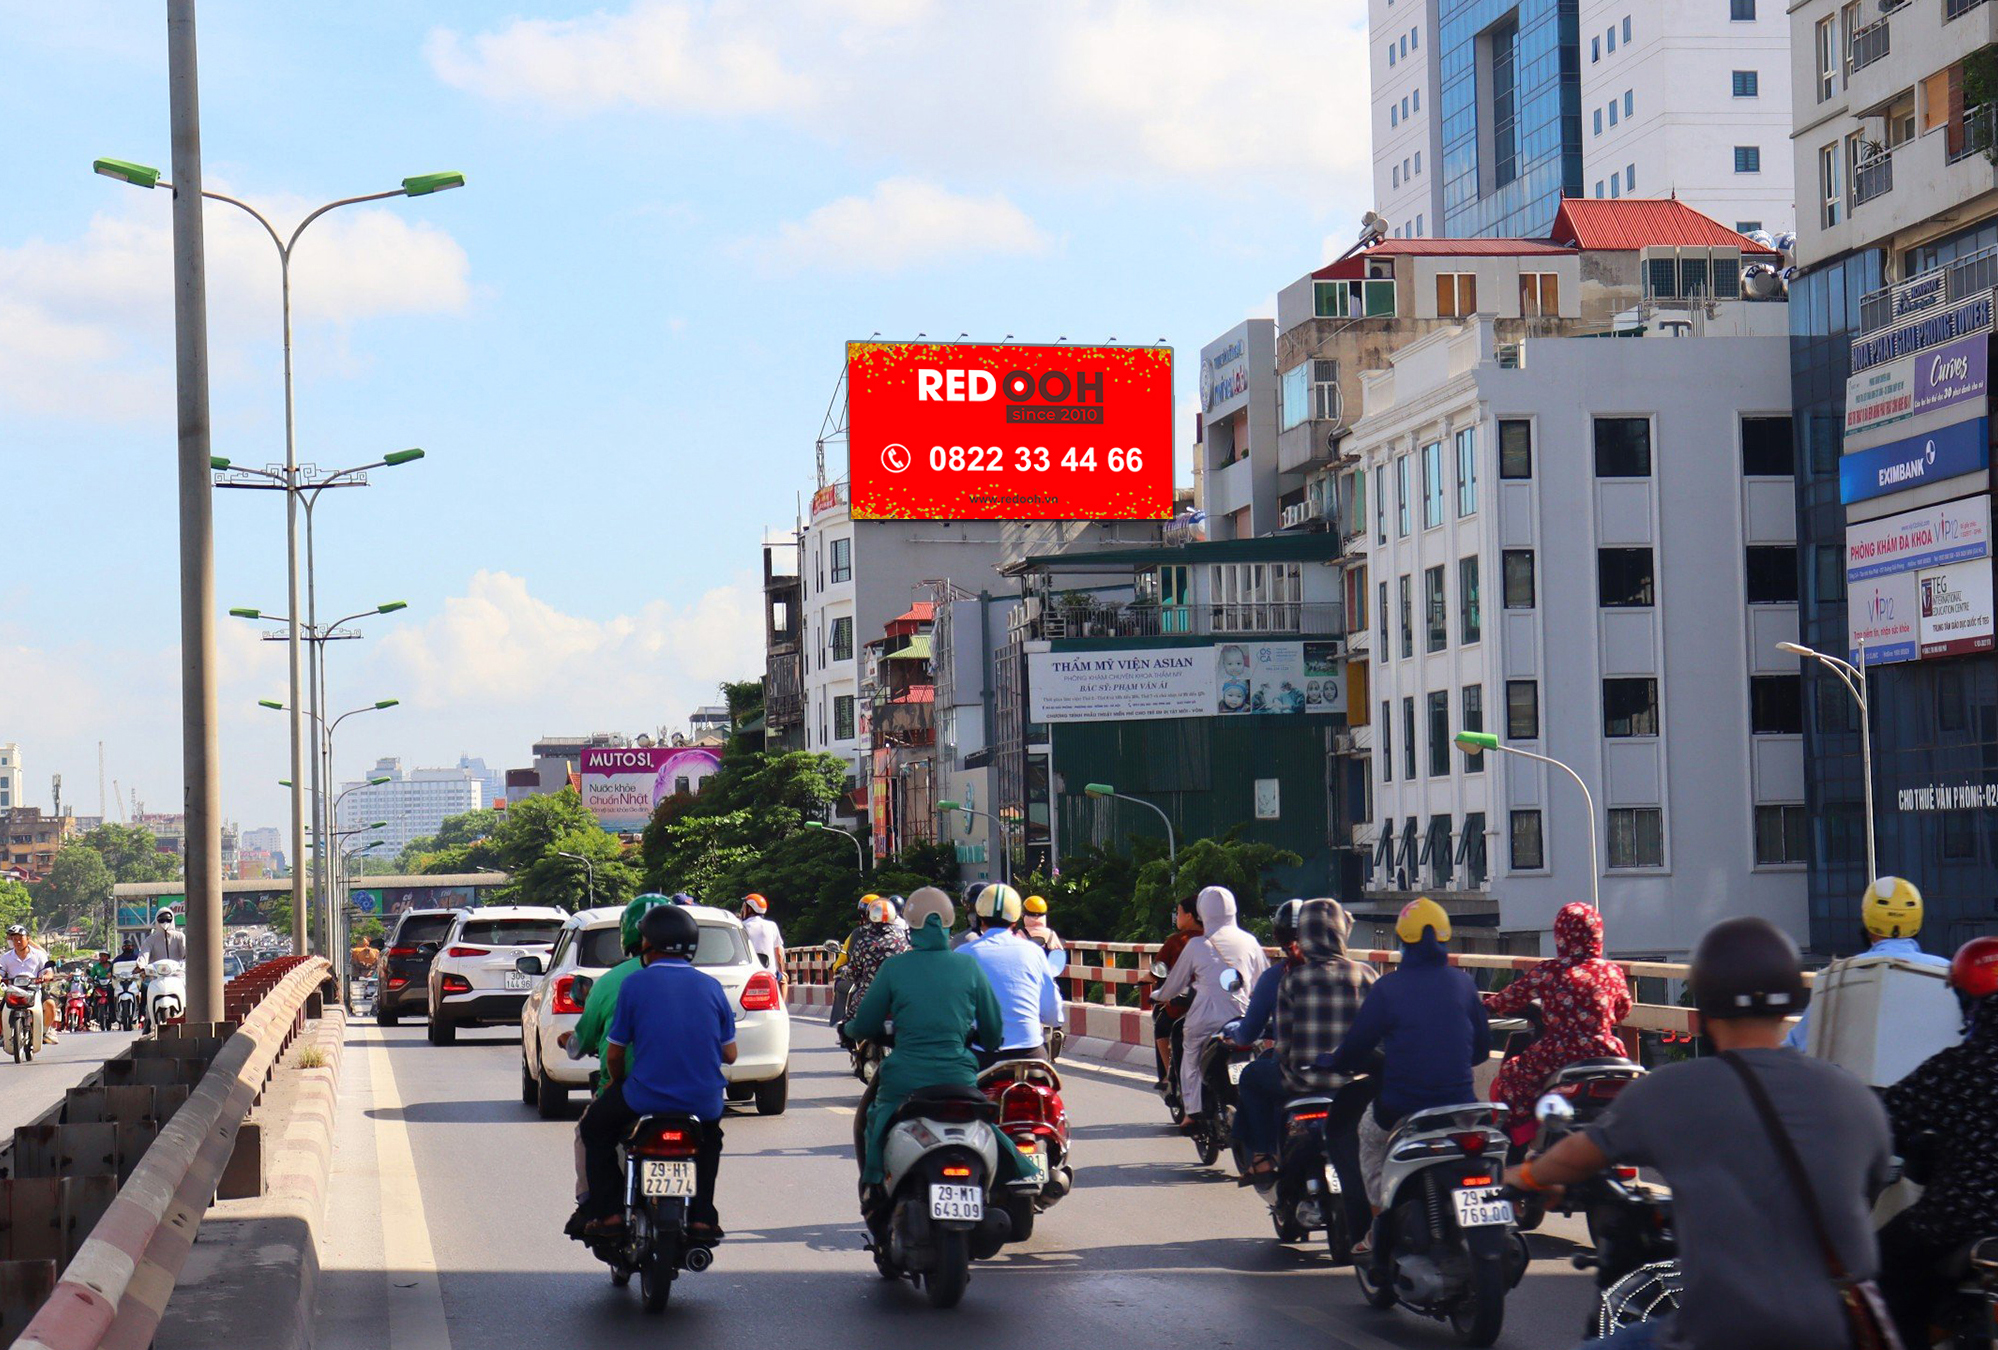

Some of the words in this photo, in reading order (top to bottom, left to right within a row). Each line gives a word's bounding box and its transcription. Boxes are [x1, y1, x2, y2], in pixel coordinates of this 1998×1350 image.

[1954, 300, 1987, 334] TOWER
[1930, 354, 1968, 387] Curves
[918, 369, 996, 401] RED
[1003, 370, 1104, 403] OOH
[1944, 387, 1952, 399] 30
[1012, 408, 1056, 421] since
[1061, 408, 1097, 421] 2010
[929, 446, 1003, 471] 0822
[1014, 447, 1050, 472] 33
[1061, 447, 1097, 471] 44
[1107, 447, 1143, 472] 66
[1878, 458, 1924, 486] EXIMBANK
[970, 494, 1058, 505] www.redooh.vn
[1850, 542, 1875, 561] PHÒNG
[1877, 530, 1898, 555] KHÁM
[1899, 534, 1910, 551] ĐA
[1912, 528, 1933, 548] KHOA
[1932, 575, 1947, 594] TEG
[1932, 604, 1955, 616] EDUCATION
[1955, 602, 1970, 613] CENTRE
[1052, 656, 1091, 672] THẨM
[1095, 658, 1114, 671] MỸ
[1118, 656, 1150, 671] VIỆN
[1153, 657, 1193, 669] ASIAN
[1080, 684, 1097, 692] BÁC
[1113, 683, 1138, 692] PHẠM
[589, 752, 651, 767] MUTOSI
[589, 783, 613, 793] Nước
[615, 783, 636, 793] khỏe
[590, 794, 619, 805] Chuẩn
[620, 793, 648, 806] Nhật
[1898, 789, 1914, 811] CHO
[1914, 783, 1934, 811] THUÊ
[1936, 783, 1951, 809] VĂN
[651, 1163, 688, 1177] 29-H1
[646, 1179, 693, 1194] 227.74
[934, 1202, 980, 1218] 643.09
[1461, 1206, 1510, 1225] 769.00
